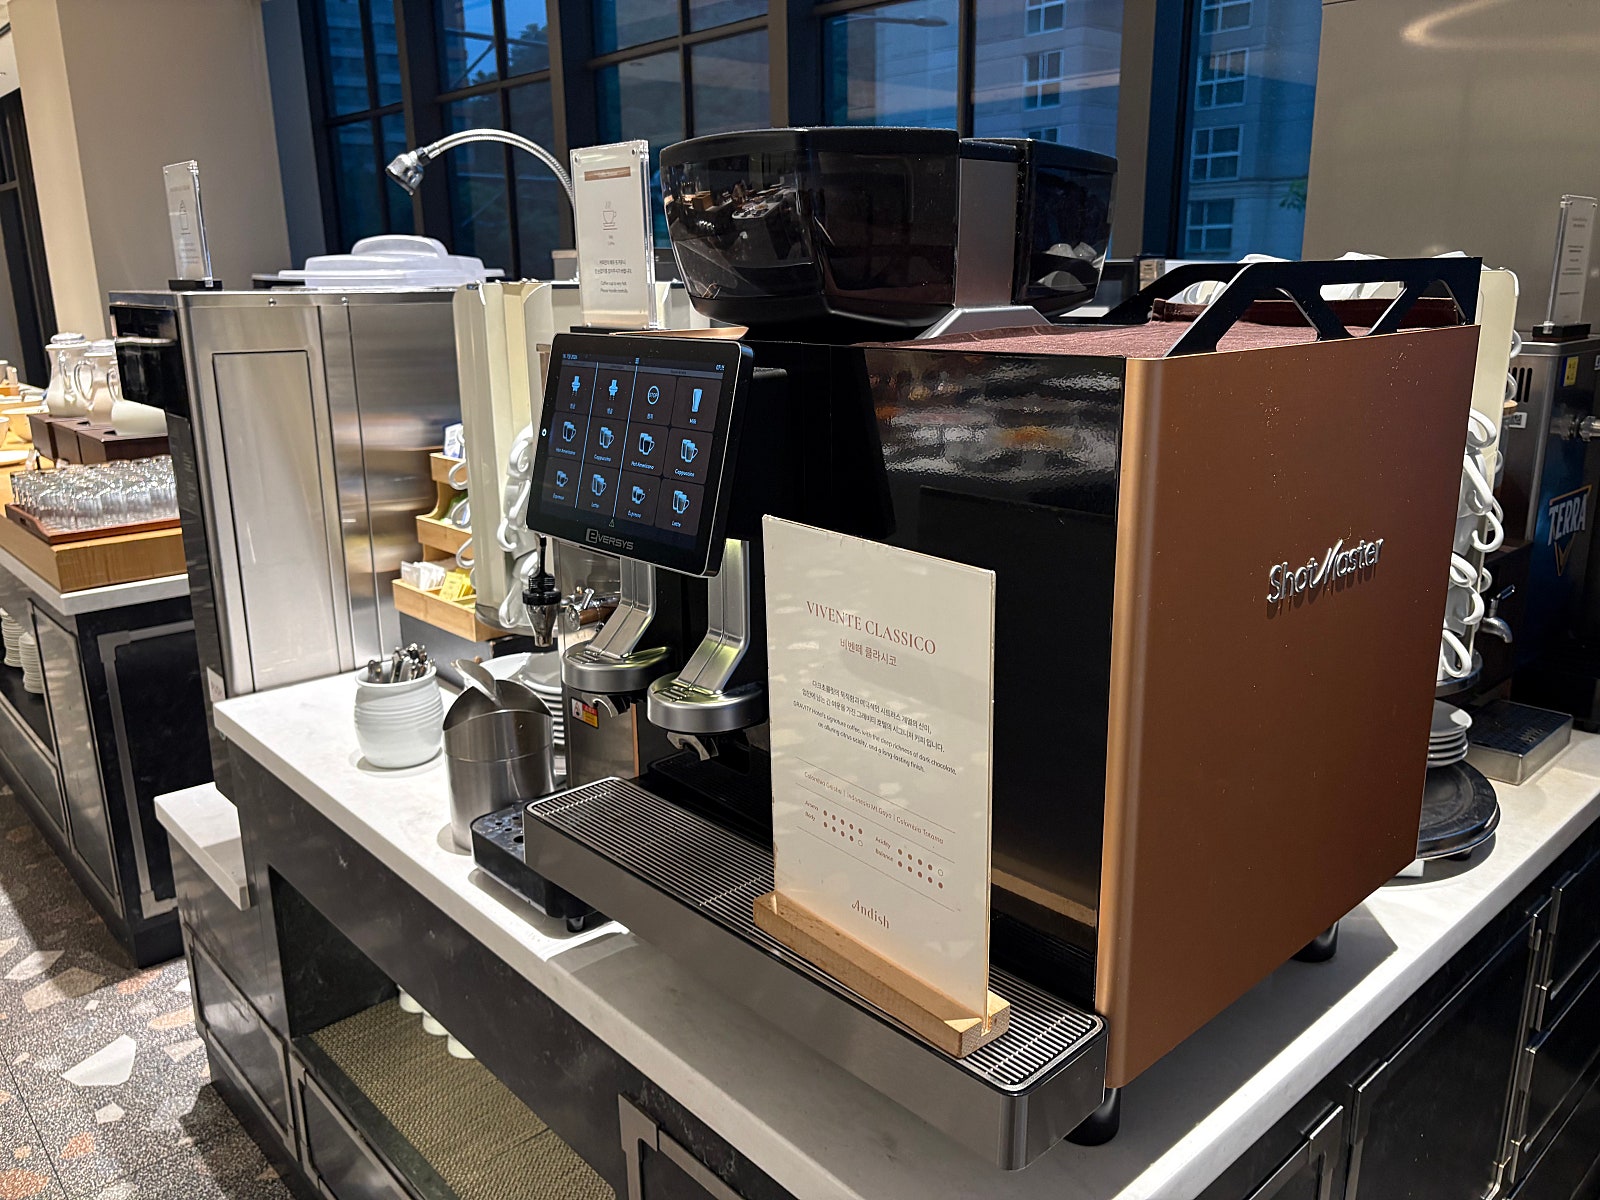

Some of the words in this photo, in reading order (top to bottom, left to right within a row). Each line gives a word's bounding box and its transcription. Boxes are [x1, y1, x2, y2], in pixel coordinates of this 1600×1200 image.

[1547, 494, 1587, 547] TERRA
[806, 601, 861, 630] VIVENTE
[865, 620, 935, 654] CLASSICO
[865, 647, 896, 667] 클라시코
[851, 900, 889, 928] Andish
